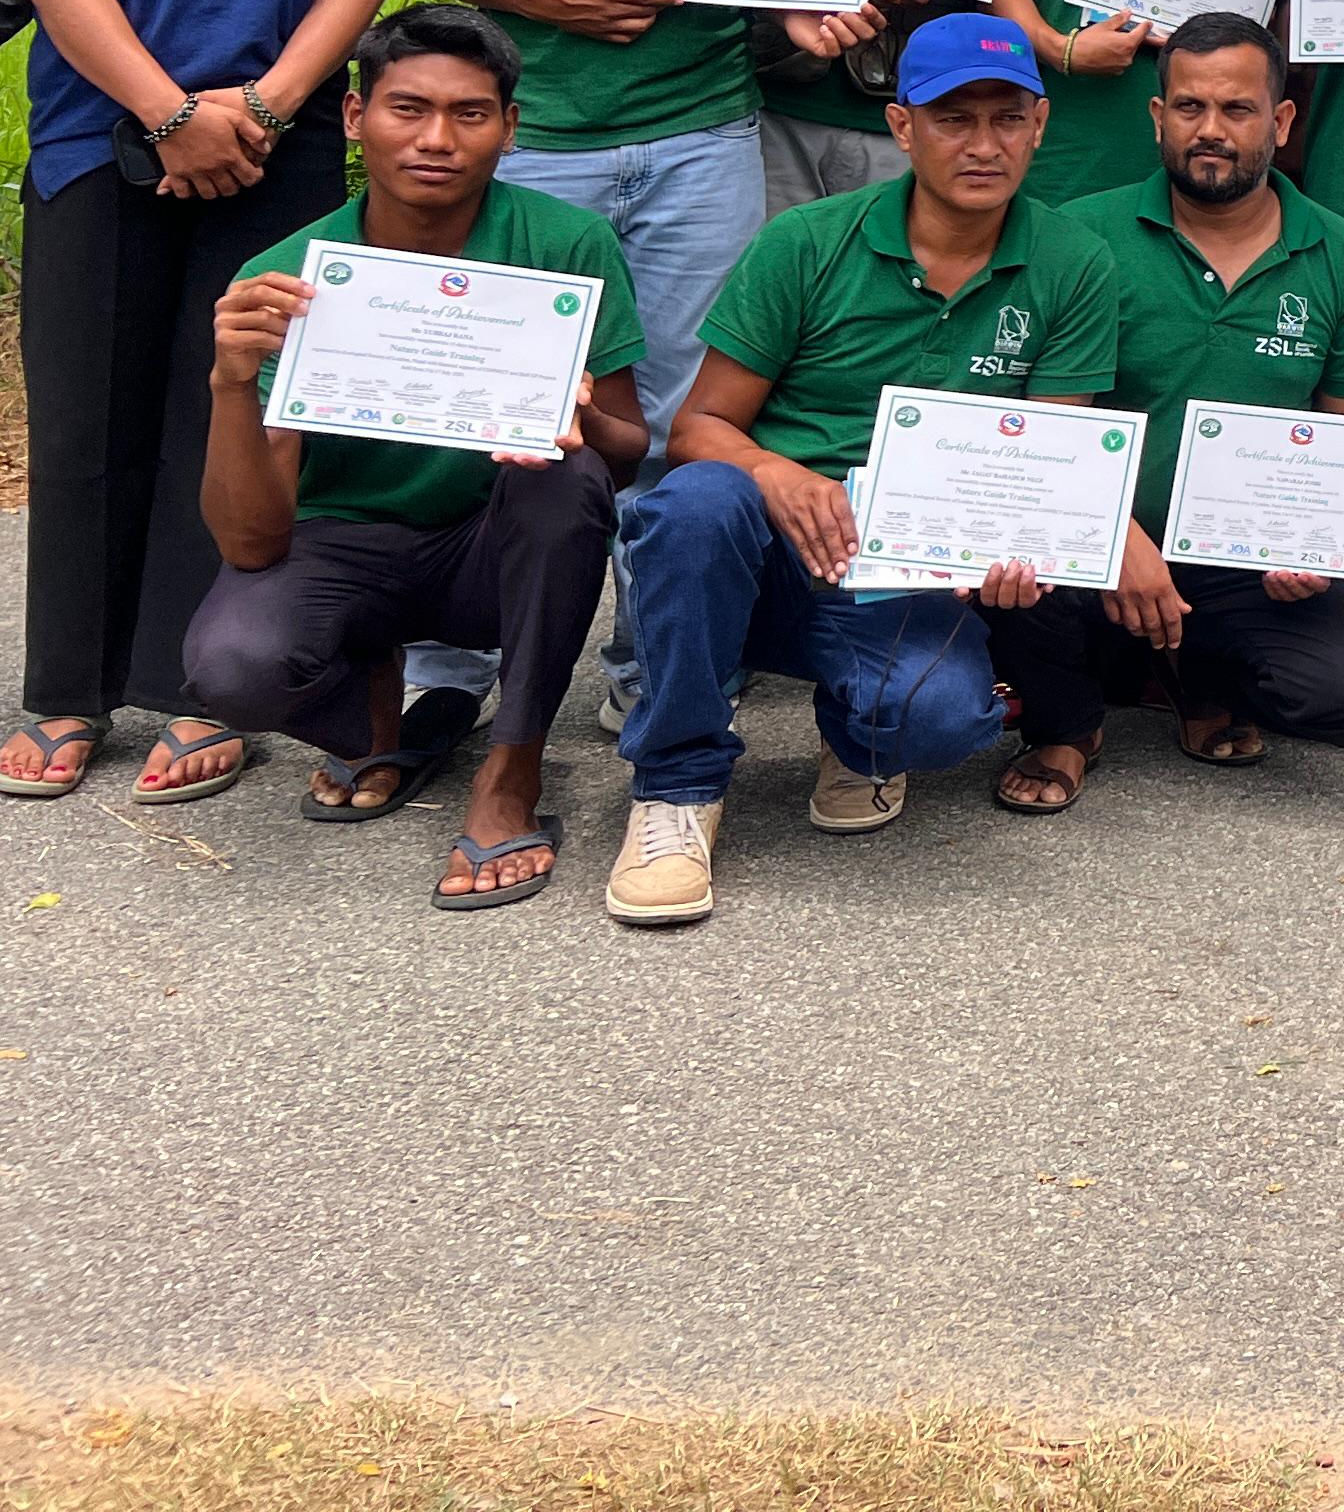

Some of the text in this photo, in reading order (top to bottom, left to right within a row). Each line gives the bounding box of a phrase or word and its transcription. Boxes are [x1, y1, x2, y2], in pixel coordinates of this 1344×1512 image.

[431, 304, 449, 319] of
[1255, 337, 1293, 357] ZSL
[970, 355, 1005, 377] ZSL
[444, 419, 476, 434] ZSL
[991, 444, 1008, 458] of
[1284, 453, 1299, 465] of
[1300, 551, 1326, 564] ZSL
